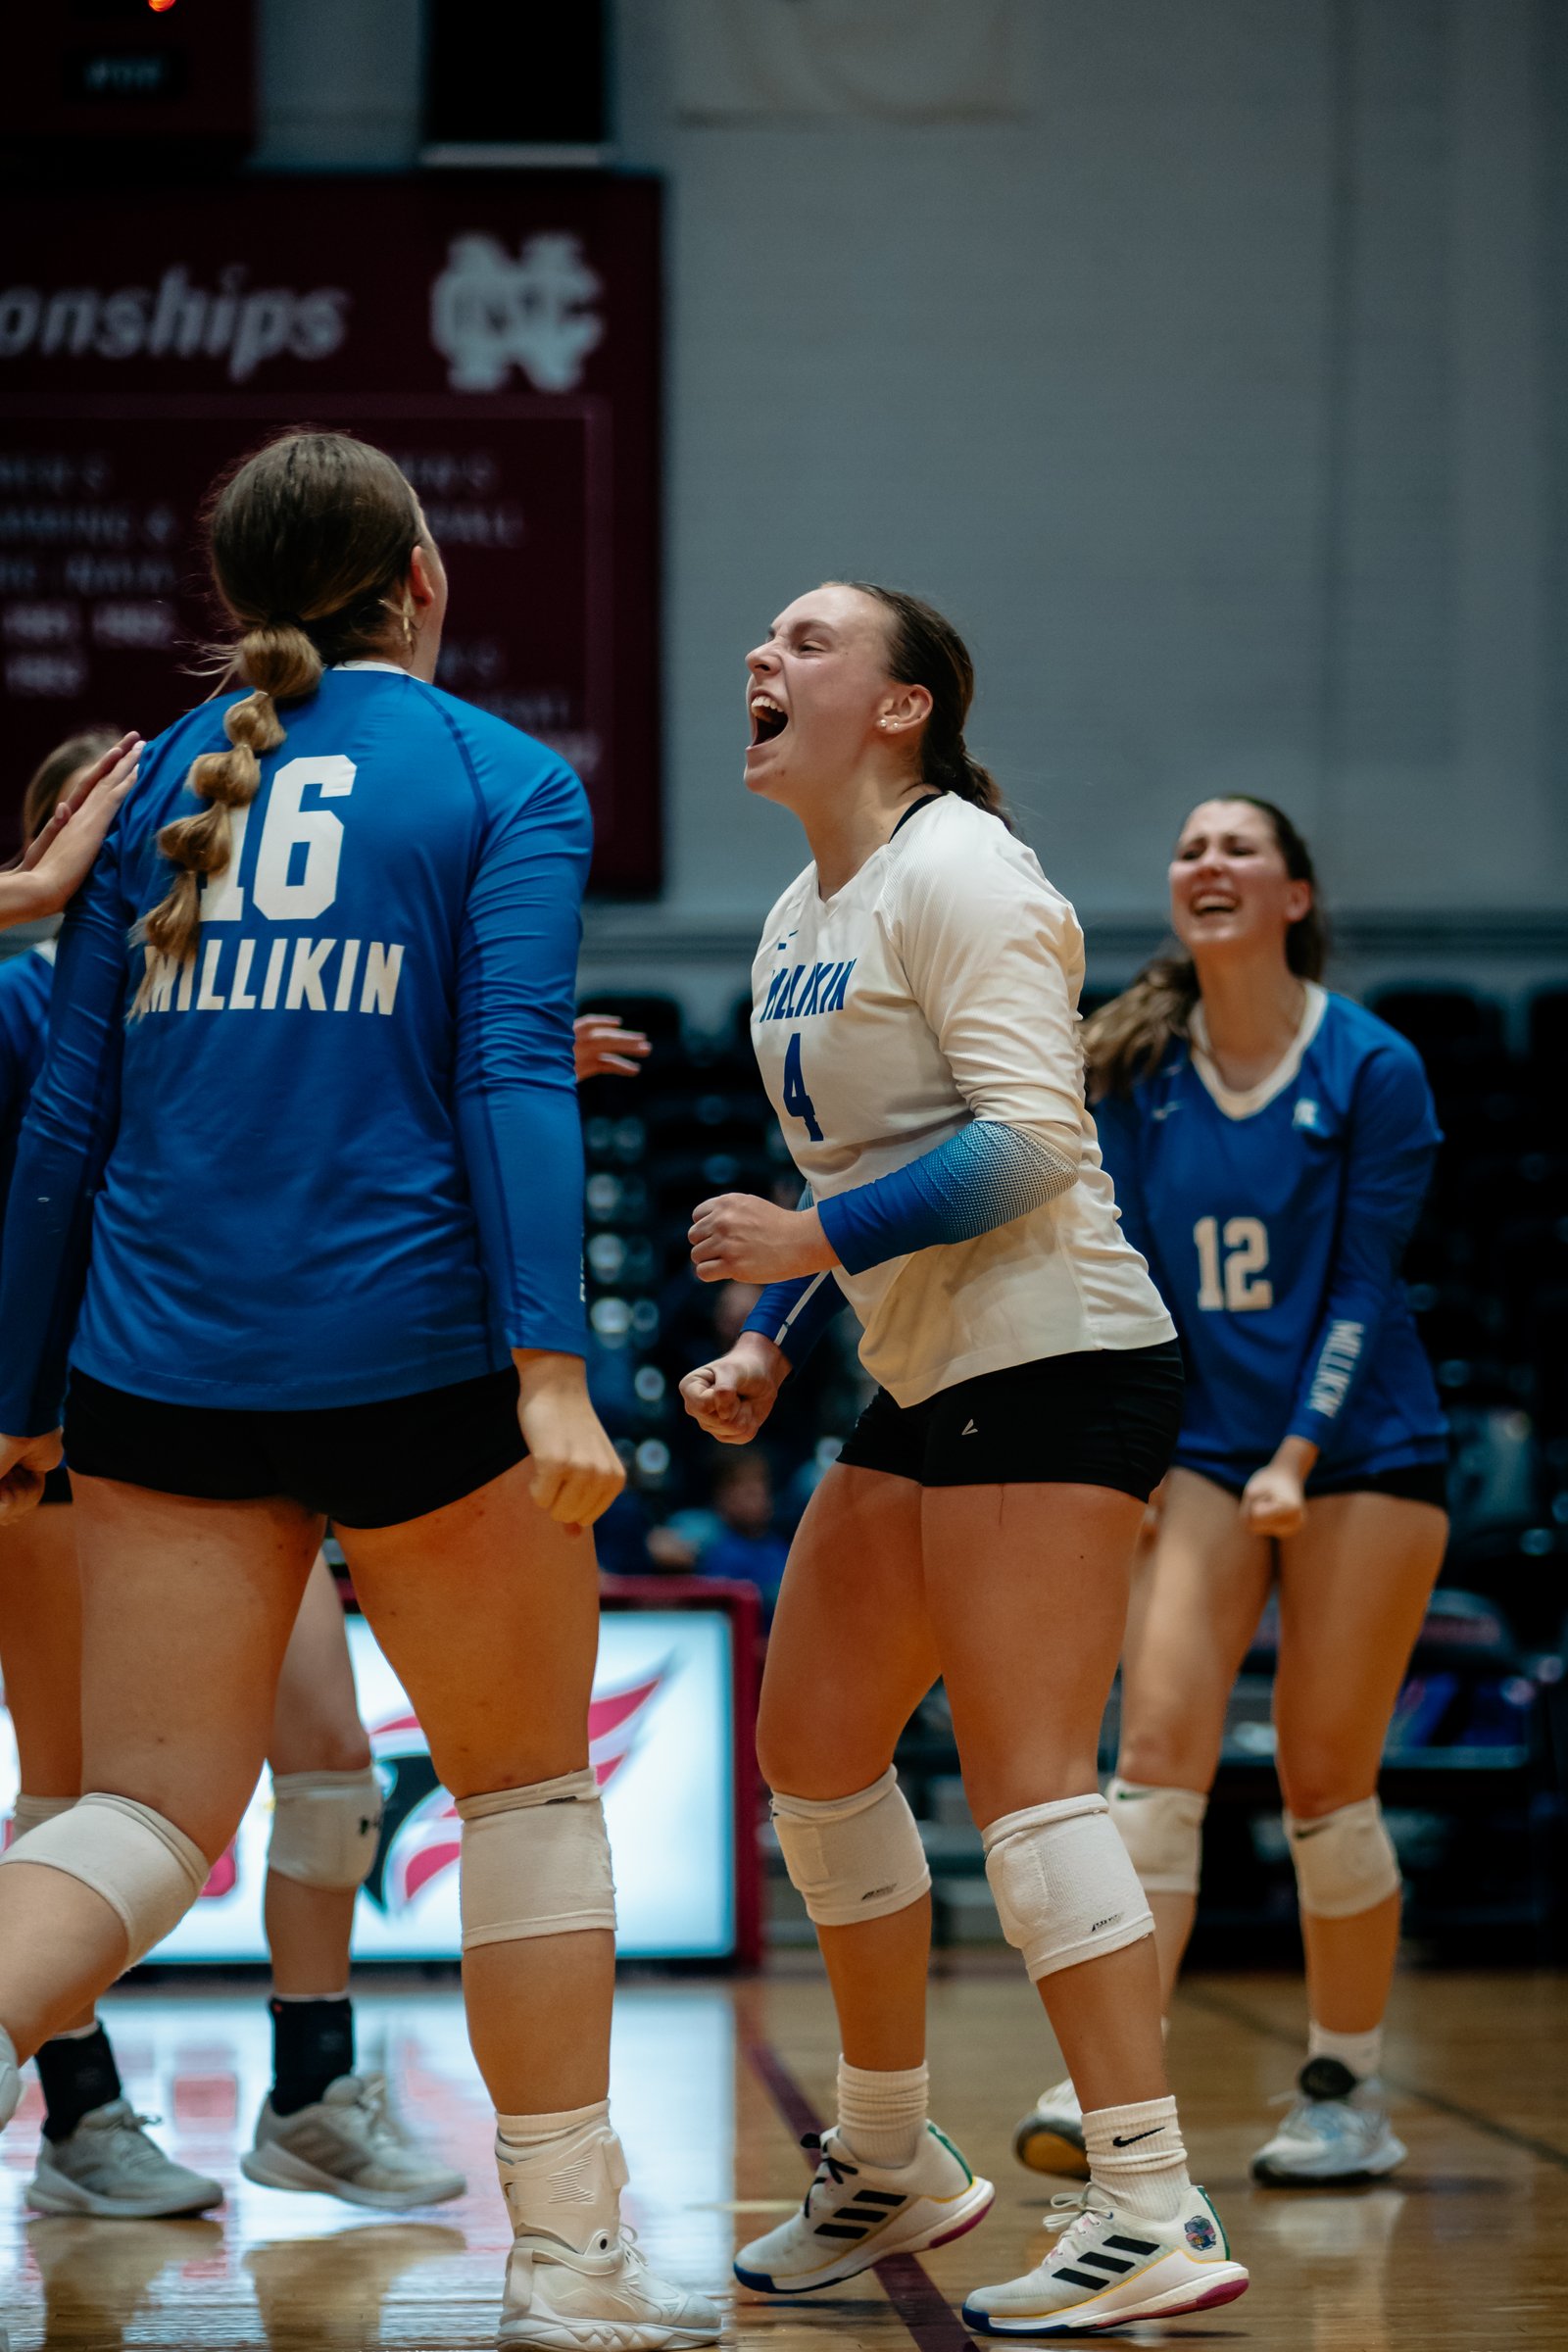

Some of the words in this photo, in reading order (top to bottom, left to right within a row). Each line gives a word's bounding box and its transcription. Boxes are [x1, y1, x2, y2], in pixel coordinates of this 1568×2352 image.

[195, 754, 358, 922] 16
[143, 937, 405, 1016] MILLIKIN
[783, 1032, 825, 1143] 4
[1193, 1215, 1273, 1312] 12
